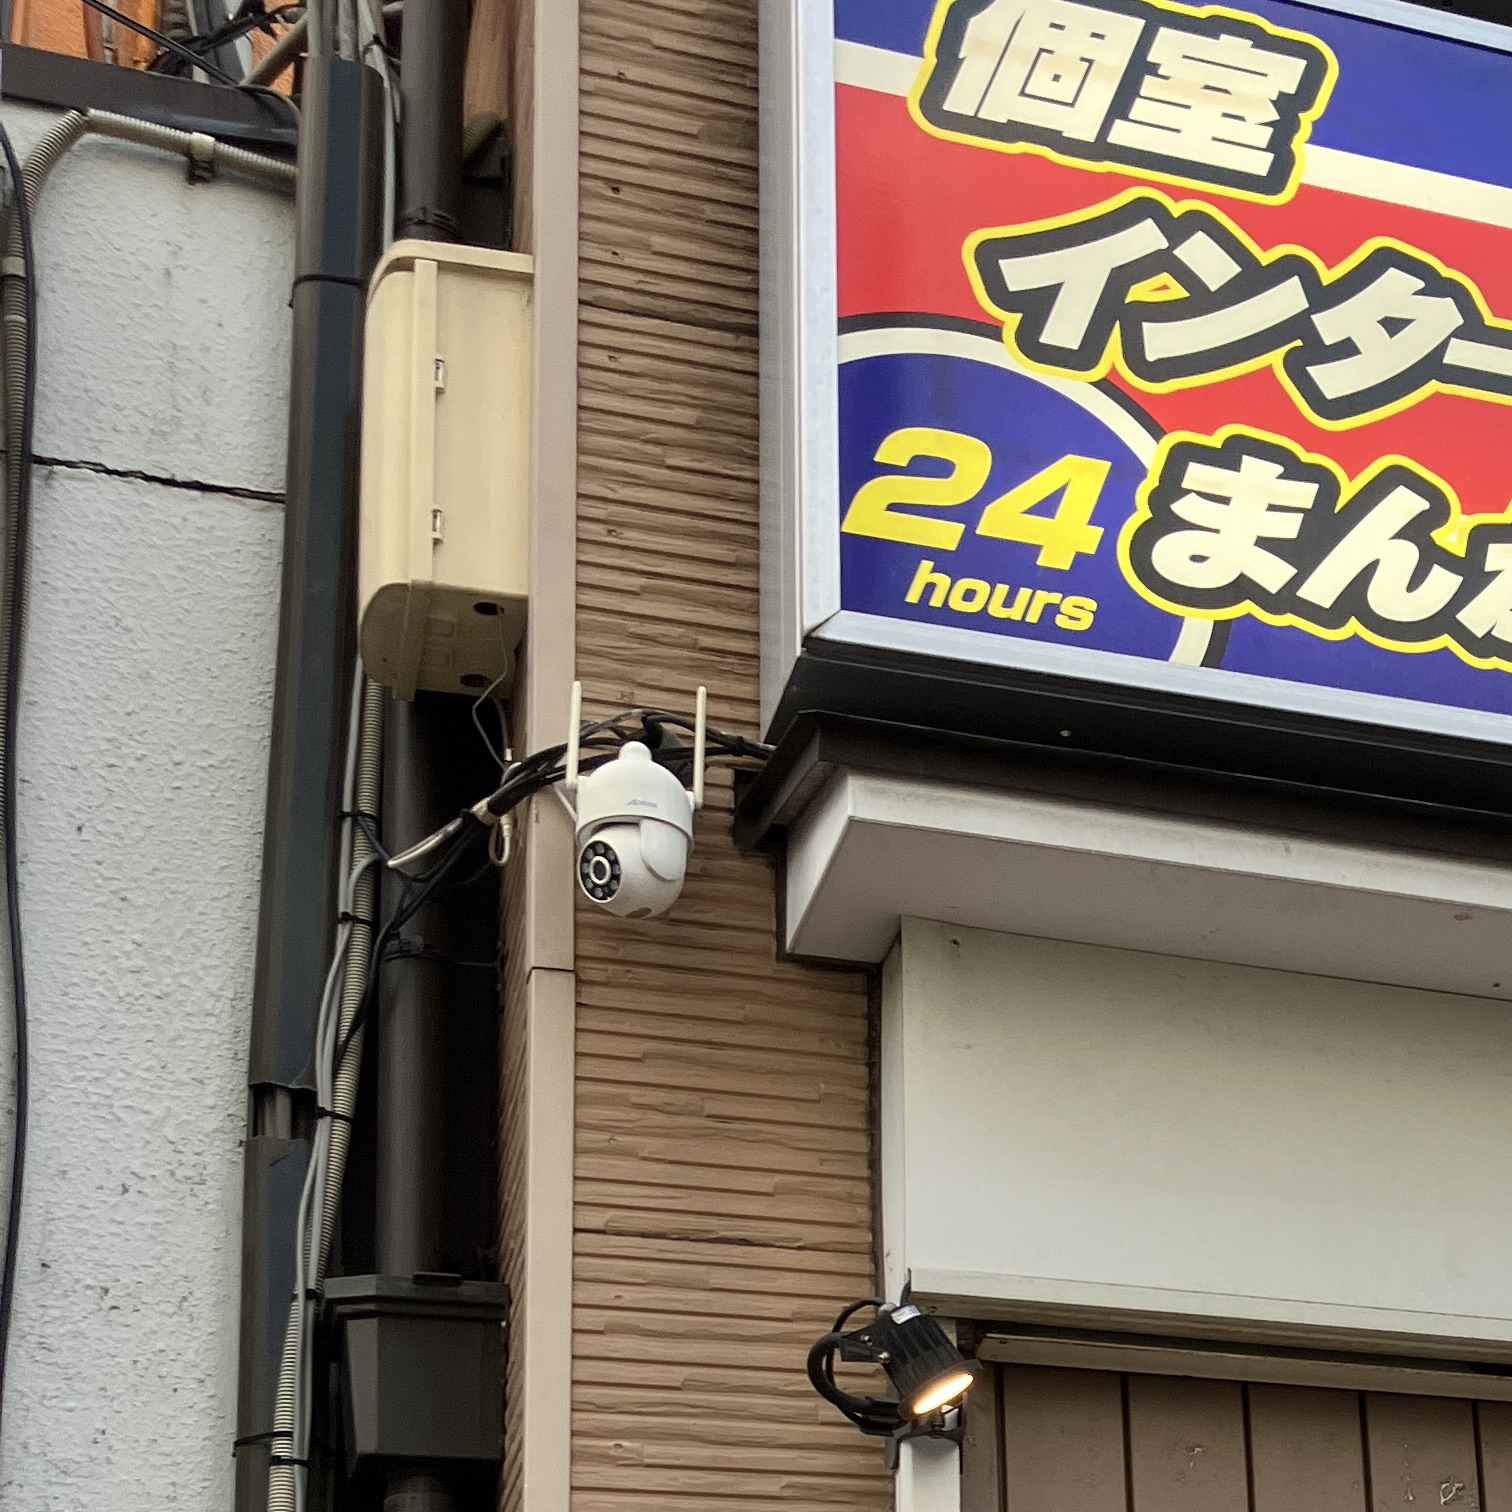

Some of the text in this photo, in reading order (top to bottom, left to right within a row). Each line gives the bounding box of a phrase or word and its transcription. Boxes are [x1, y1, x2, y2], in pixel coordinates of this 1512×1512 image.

[942, 0, 1307, 177] 個室
[841, 427, 1112, 571] 24
[904, 560, 1098, 631] hours
